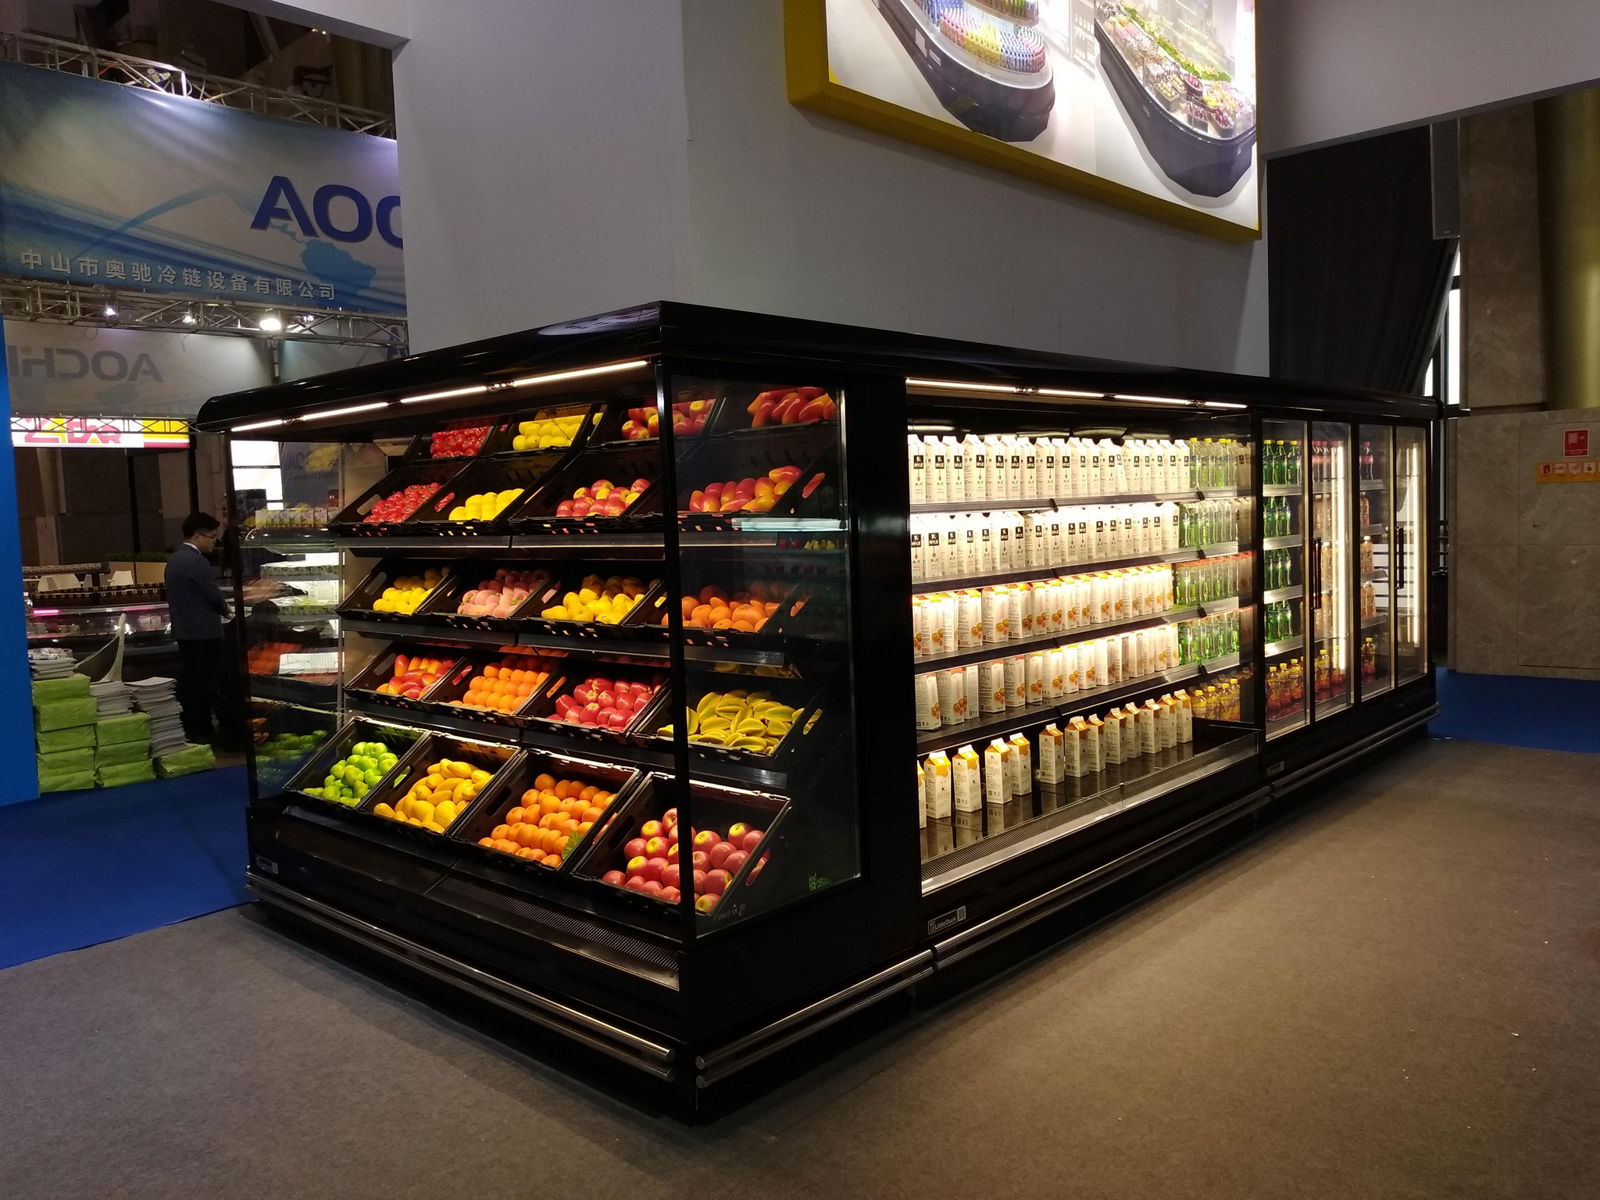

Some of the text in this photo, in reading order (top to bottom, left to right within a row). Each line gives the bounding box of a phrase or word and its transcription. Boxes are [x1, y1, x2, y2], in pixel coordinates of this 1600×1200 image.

[20, 248, 336, 301] 中山市奥驰冷链设备有限公司
